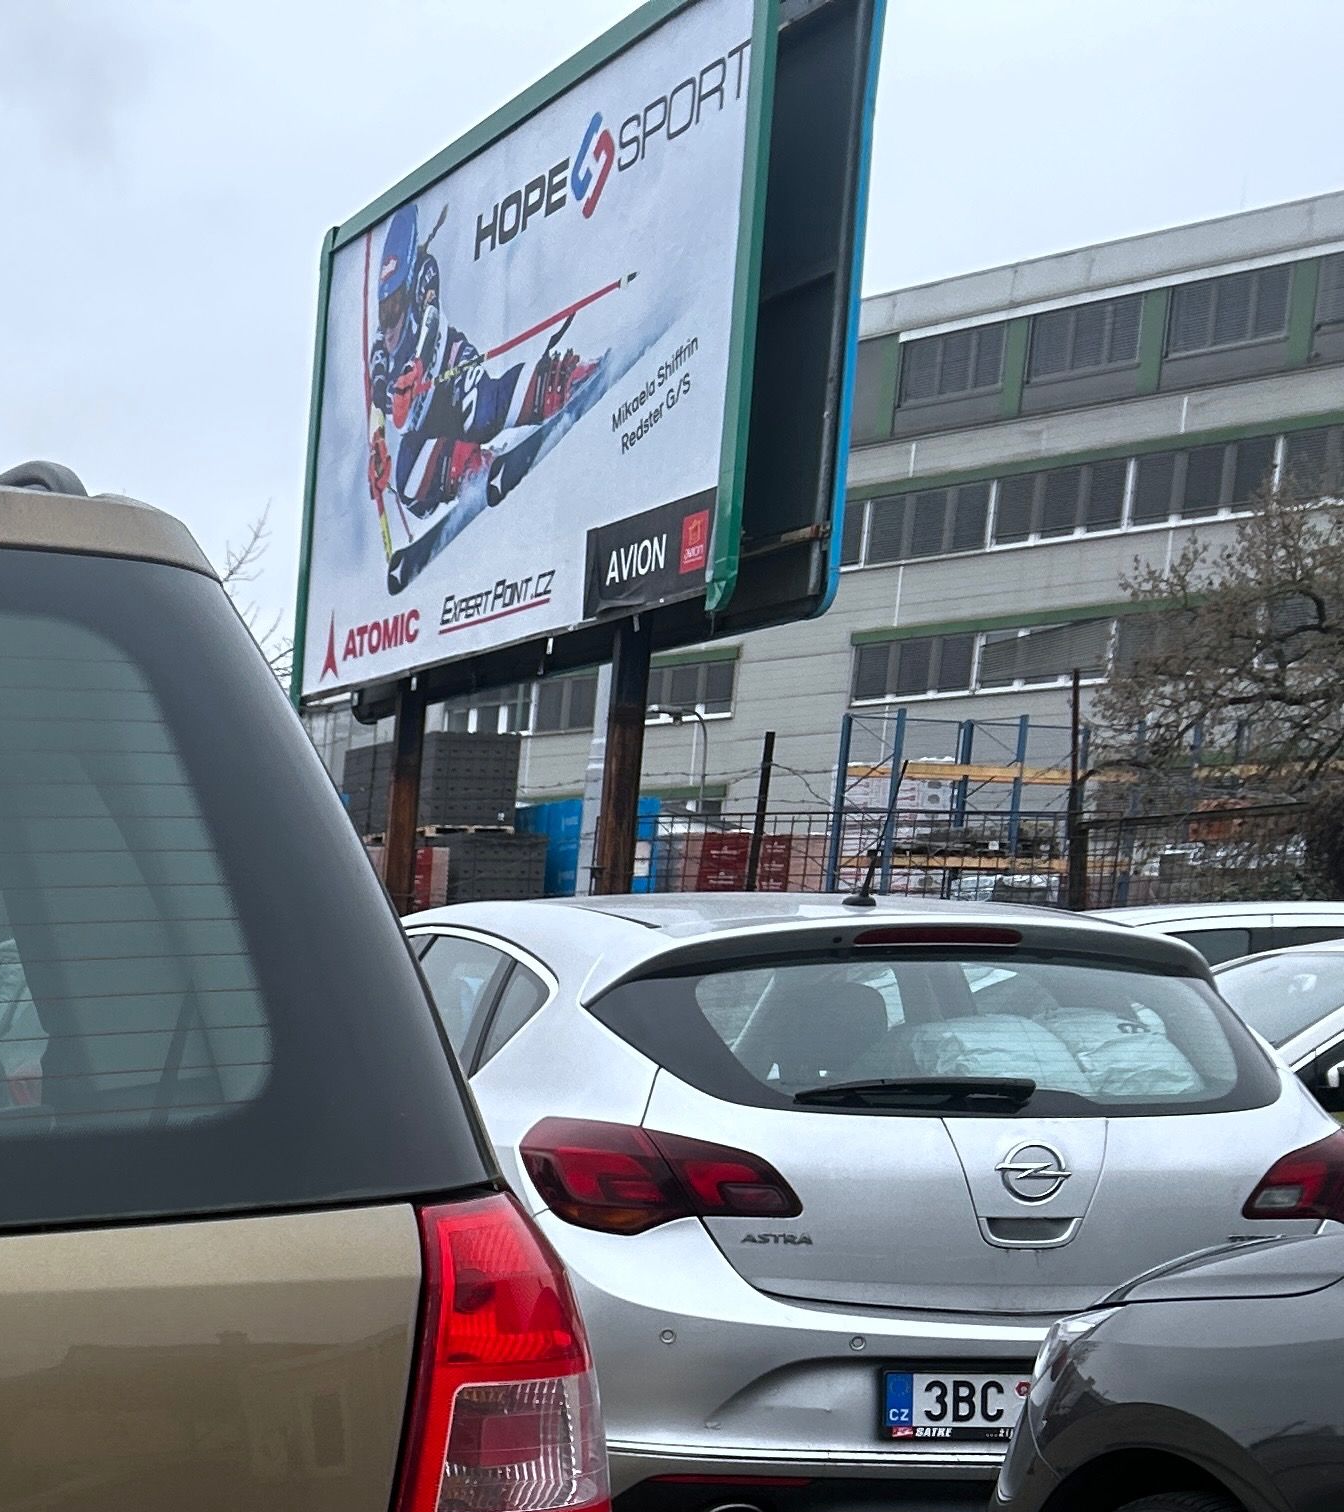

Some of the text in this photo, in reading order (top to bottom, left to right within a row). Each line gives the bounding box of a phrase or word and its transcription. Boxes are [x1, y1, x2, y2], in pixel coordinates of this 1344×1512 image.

[473, 37, 752, 262] HOPE SPORT
[612, 336, 699, 432] Mikaela Shiffrin
[621, 402, 664, 455] Redster
[605, 533, 667, 586] AVION
[342, 608, 420, 661] ATOMIC
[740, 1232, 813, 1245] ASTRA
[889, 1408, 910, 1421] CZ
[924, 1380, 1005, 1422] 3BC
